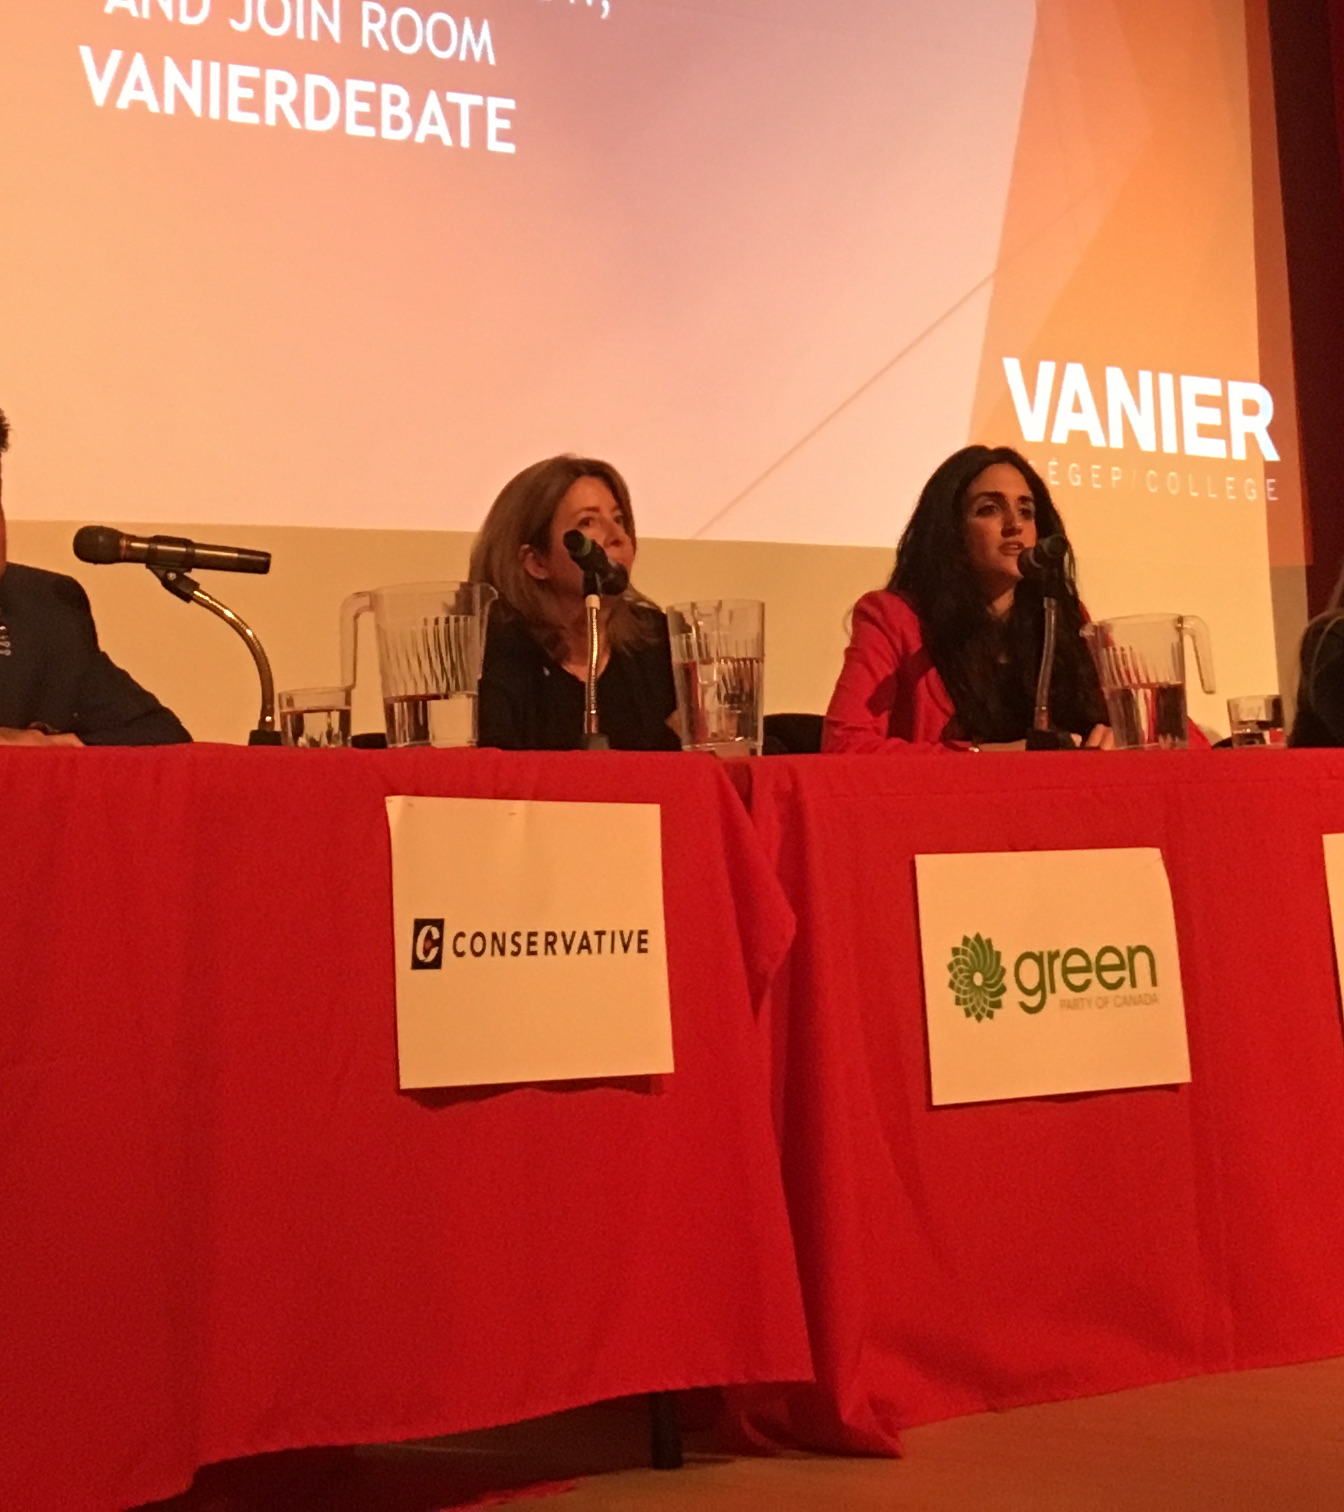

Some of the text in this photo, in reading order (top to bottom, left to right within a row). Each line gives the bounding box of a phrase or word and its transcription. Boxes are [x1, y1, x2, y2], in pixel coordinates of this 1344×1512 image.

[361, 1, 496, 66] ROOM
[79, 45, 517, 154] VANIERDEBATE
[1002, 357, 1281, 462] VANIER
[452, 929, 650, 958] CONSERVATIVE
[1014, 944, 1158, 1015] green
[1059, 992, 1159, 1010] PARTY OF CANADA
